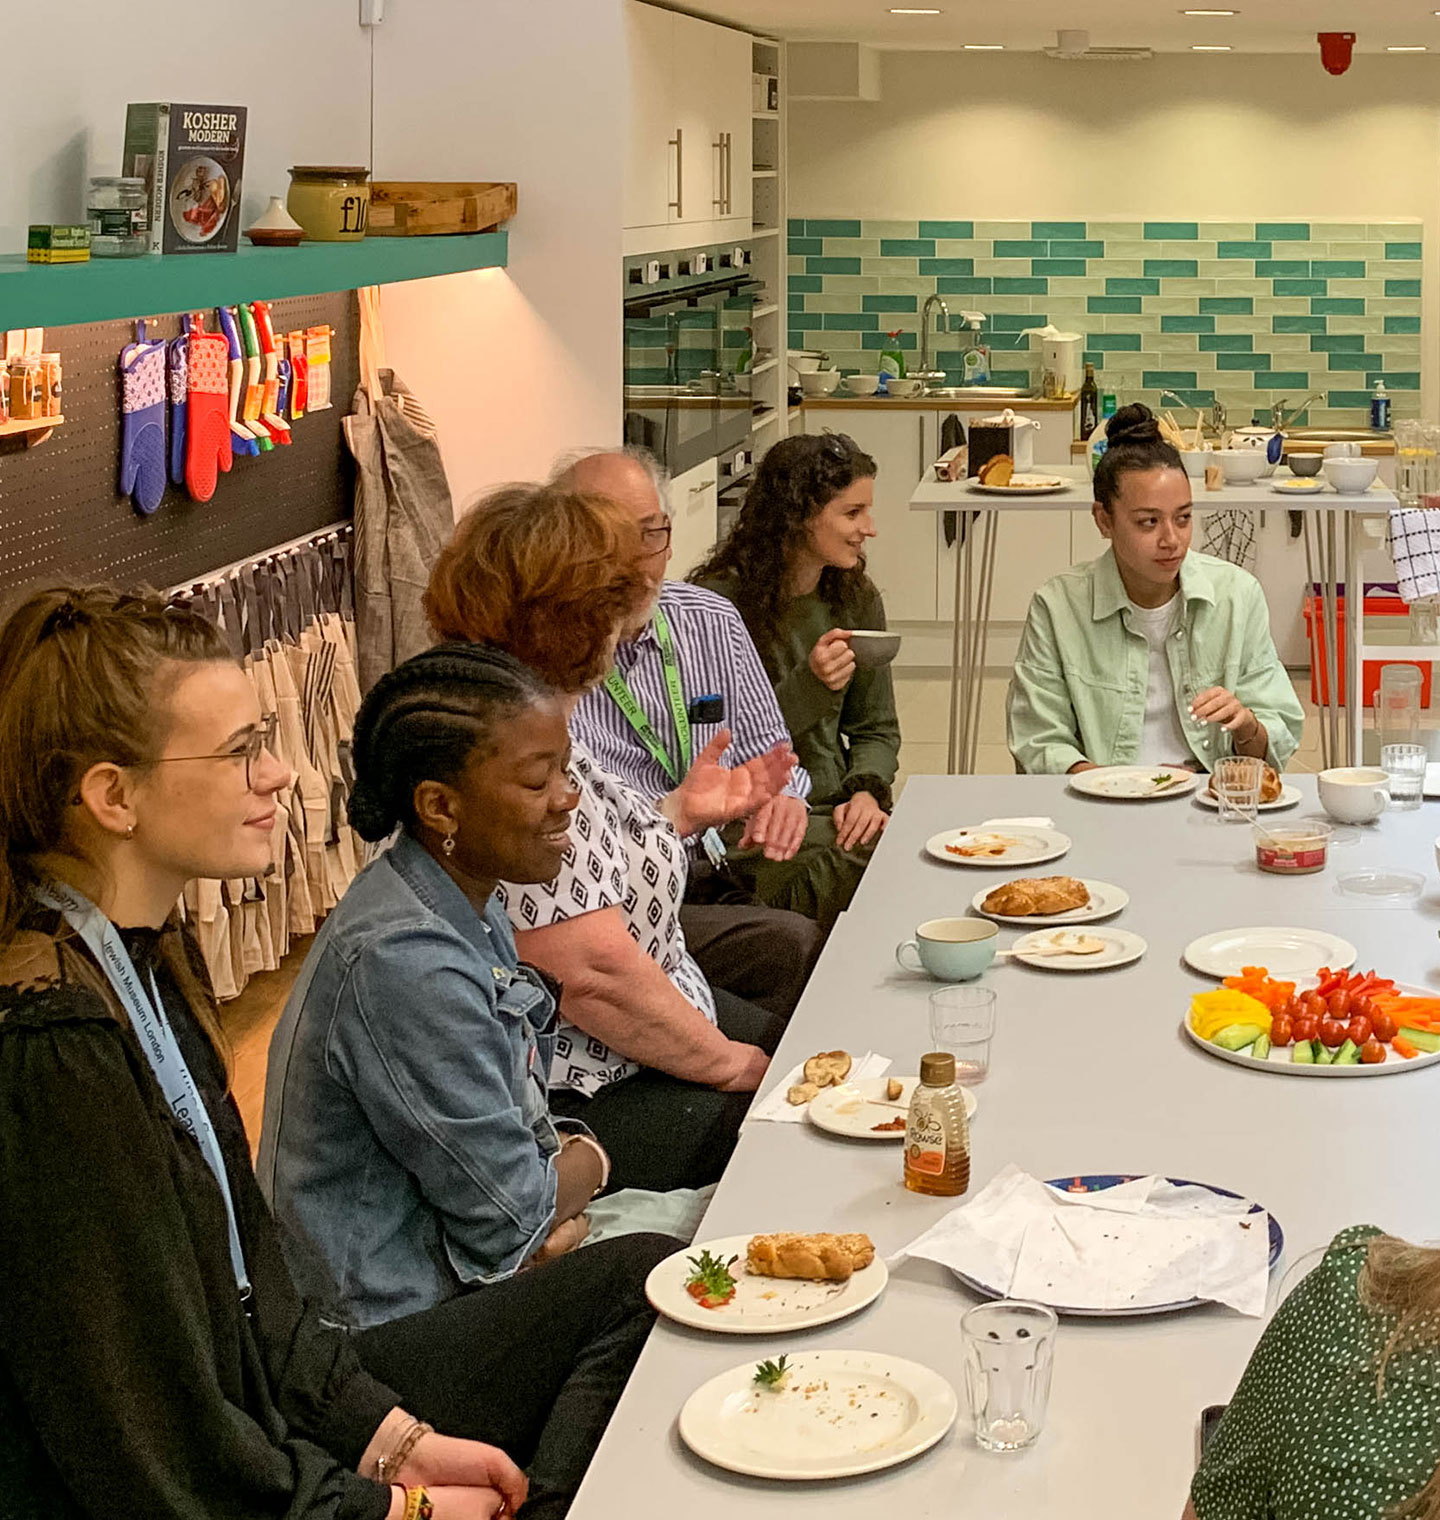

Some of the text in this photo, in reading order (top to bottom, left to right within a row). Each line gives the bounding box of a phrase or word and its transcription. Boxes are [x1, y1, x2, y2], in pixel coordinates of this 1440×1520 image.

[183, 112, 237, 131] KOSHER
[188, 130, 230, 143] MODERN
[154, 150, 165, 222] KOSHER MODERN
[607, 676, 637, 716] UNTEER
[671, 680, 689, 745] VOLUNTEER
[103, 939, 165, 1064] Jewish Museum London
[910, 1126, 943, 1146] Rowse
